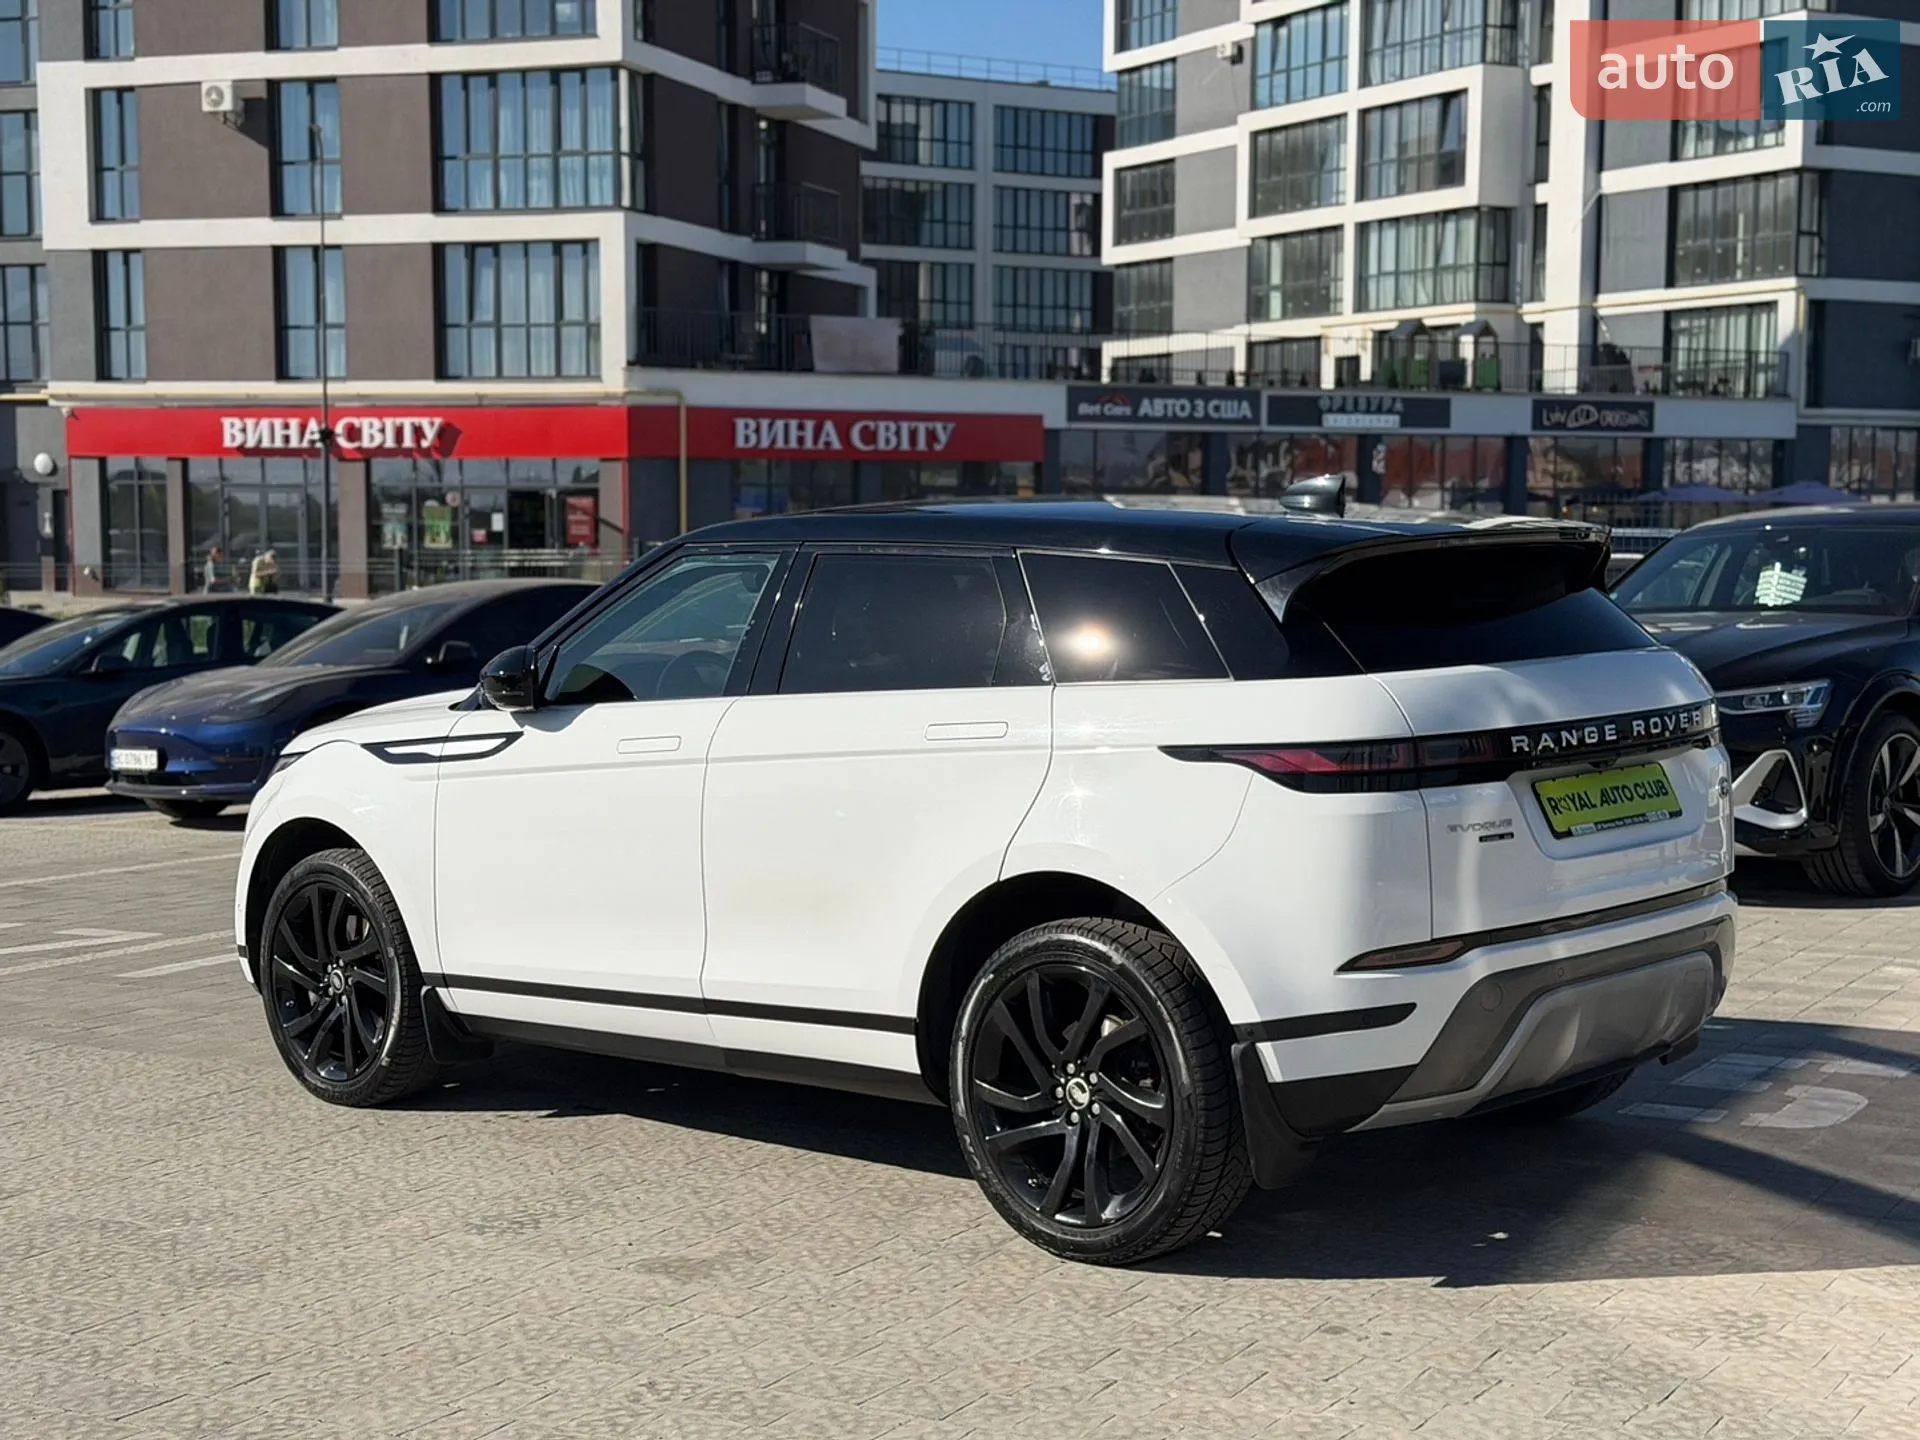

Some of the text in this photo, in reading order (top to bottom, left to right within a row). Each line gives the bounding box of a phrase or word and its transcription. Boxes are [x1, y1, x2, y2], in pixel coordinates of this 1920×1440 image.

[1138, 398, 1191, 417] АВТО
[1207, 400, 1253, 419] США
[220, 416, 443, 449] ВИНА СВІТУ
[733, 417, 956, 451] ВИНА СВІТУ
[1511, 710, 1701, 753] RANGE ROVER
[1600, 784, 1634, 807] AUTO
[1633, 779, 1669, 800] CLUB
